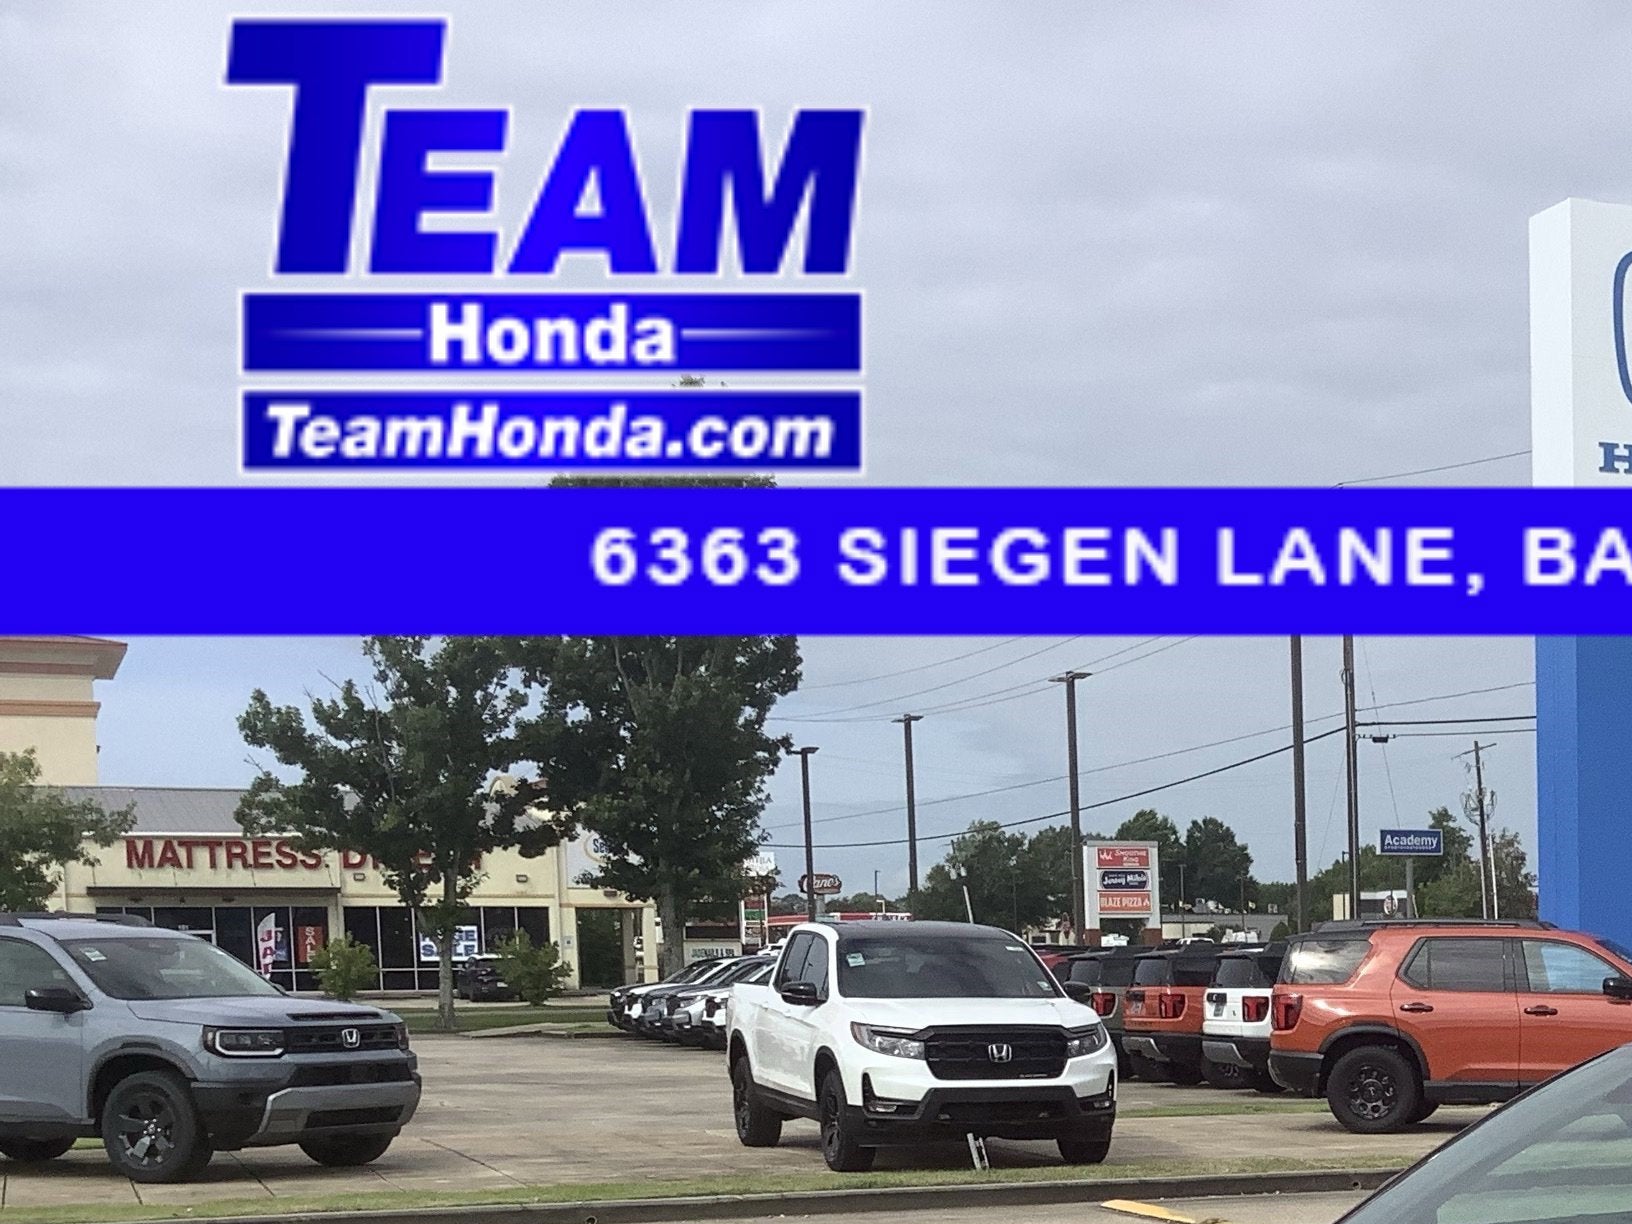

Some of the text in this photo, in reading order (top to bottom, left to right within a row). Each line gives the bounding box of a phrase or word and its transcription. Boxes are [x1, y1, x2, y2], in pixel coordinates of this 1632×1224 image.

[1384, 834, 1438, 849] Academy
[126, 839, 323, 870] MATTRESS
[1122, 896, 1142, 907] PIZZA
[421, 944, 475, 957] SLE
